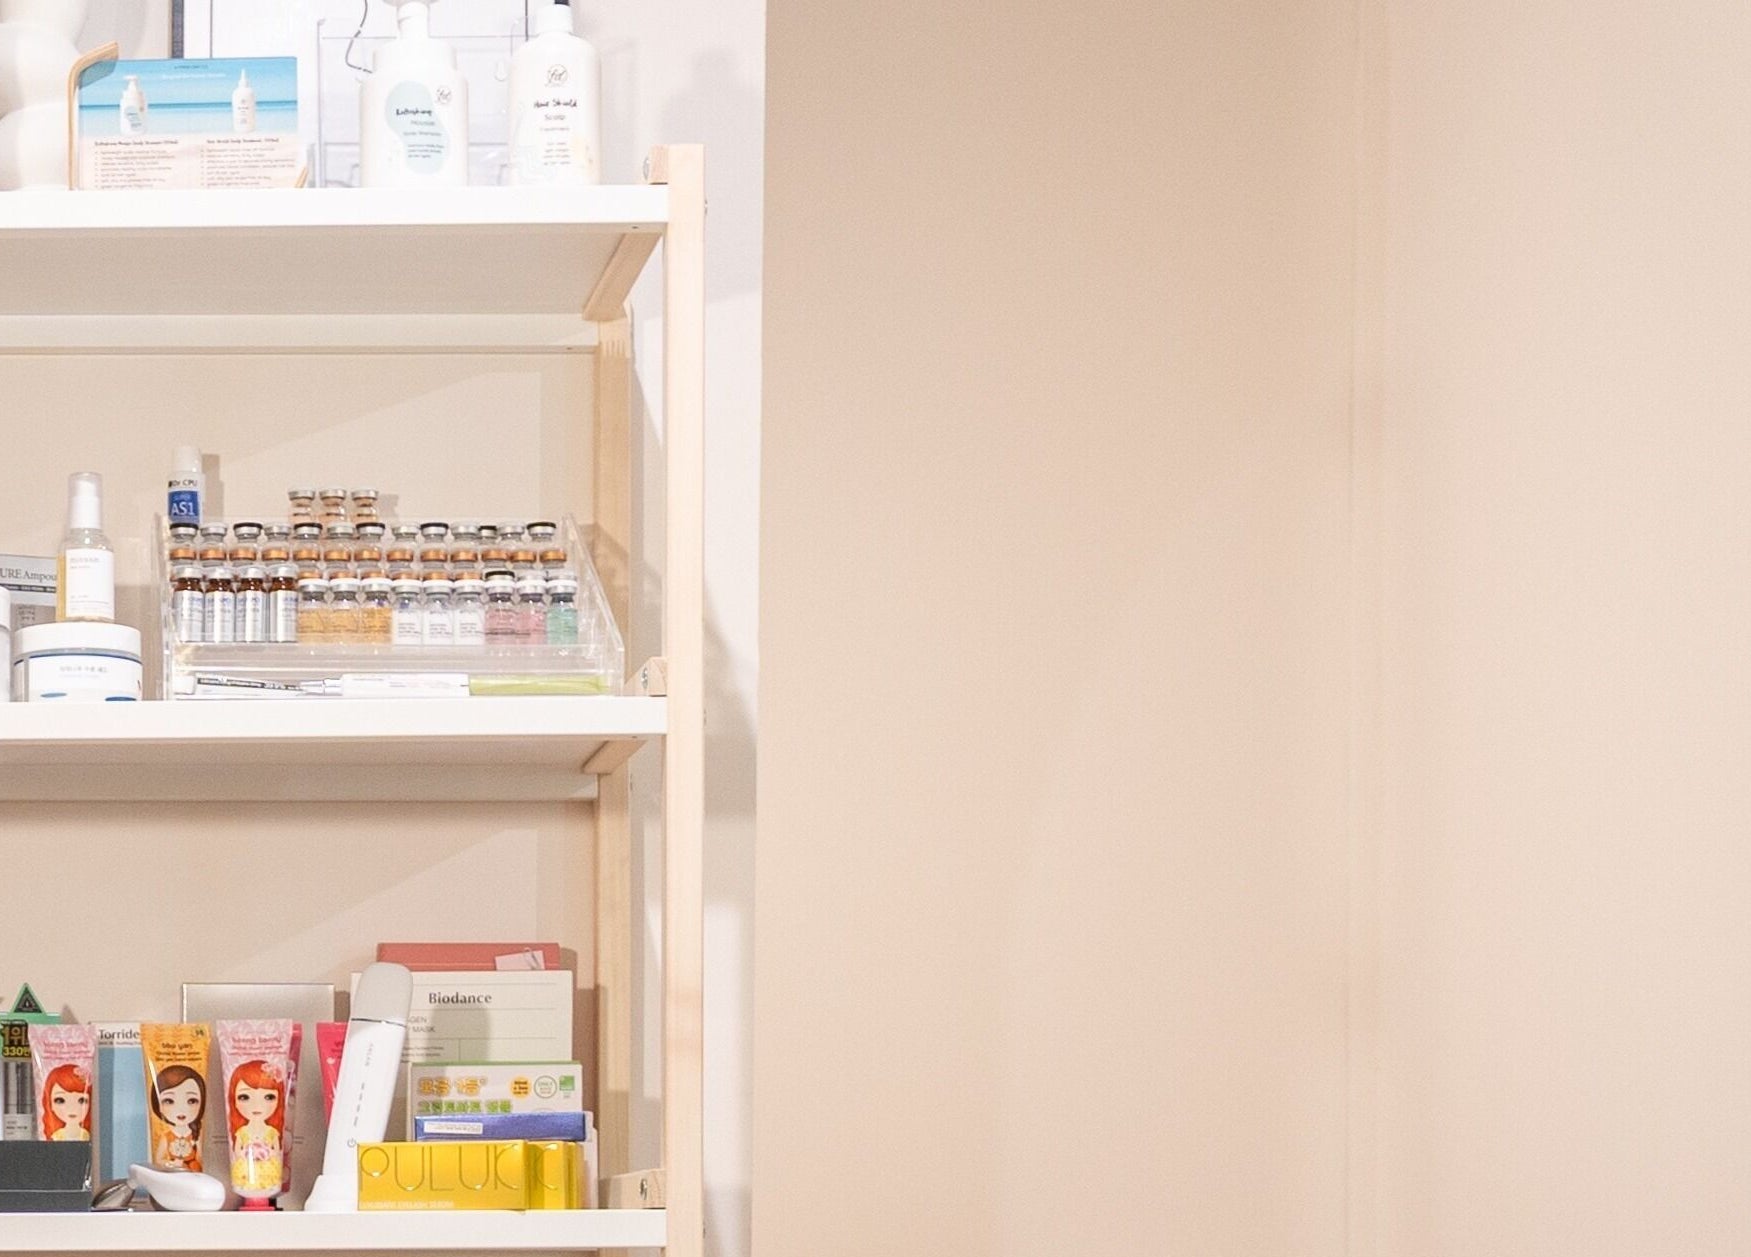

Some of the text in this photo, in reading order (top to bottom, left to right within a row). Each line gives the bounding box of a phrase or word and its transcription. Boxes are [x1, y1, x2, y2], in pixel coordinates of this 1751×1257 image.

[171, 501, 195, 516] AS1
[428, 991, 493, 1005] Biodance
[99, 1028, 140, 1040] Torride
